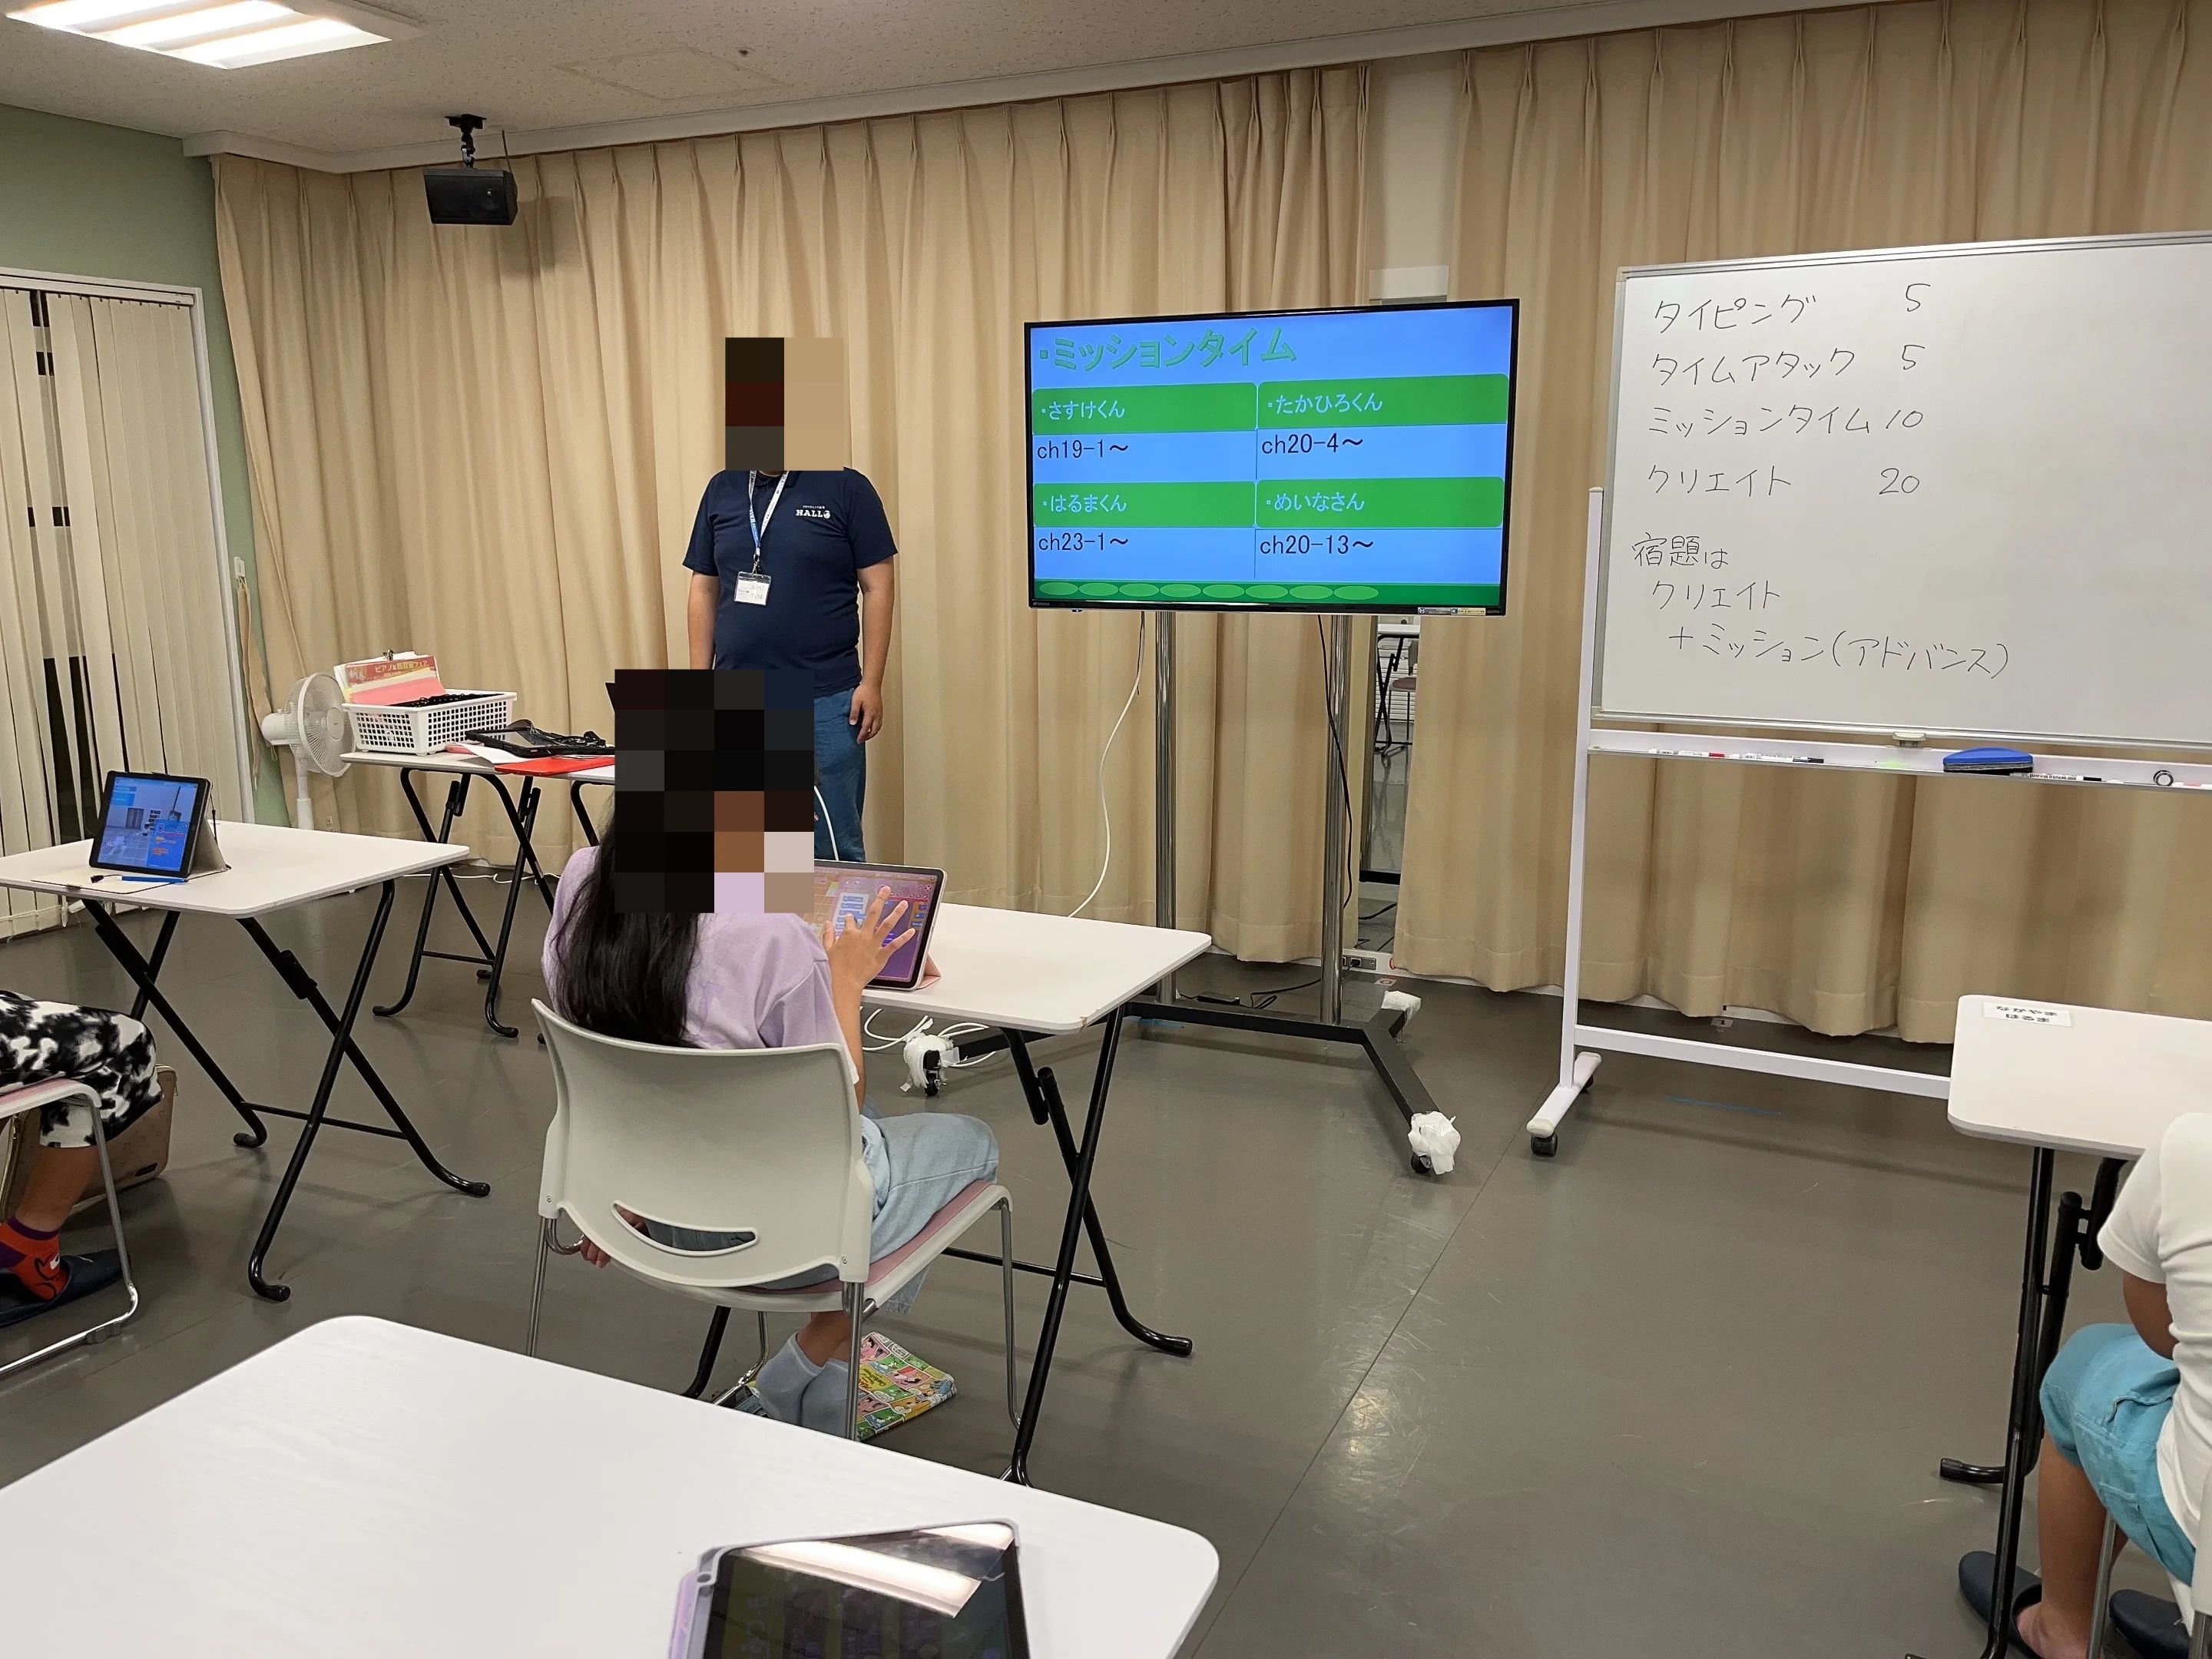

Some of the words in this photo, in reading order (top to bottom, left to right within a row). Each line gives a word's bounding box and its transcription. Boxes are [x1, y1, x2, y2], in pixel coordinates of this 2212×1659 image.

[1654, 293, 1816, 333] タイピング
[1906, 283, 1931, 313] 5
[1652, 348, 1855, 386] タイムアタック
[1901, 344, 1926, 371] 5
[1648, 404, 1870, 439] ミッションタイム
[1885, 409, 1924, 431] 10
[1647, 465, 1791, 498] クリエイト
[1878, 467, 1920, 495] 20
[1631, 531, 1729, 570] 宿題は
[1652, 580, 1780, 611] クリエイト
